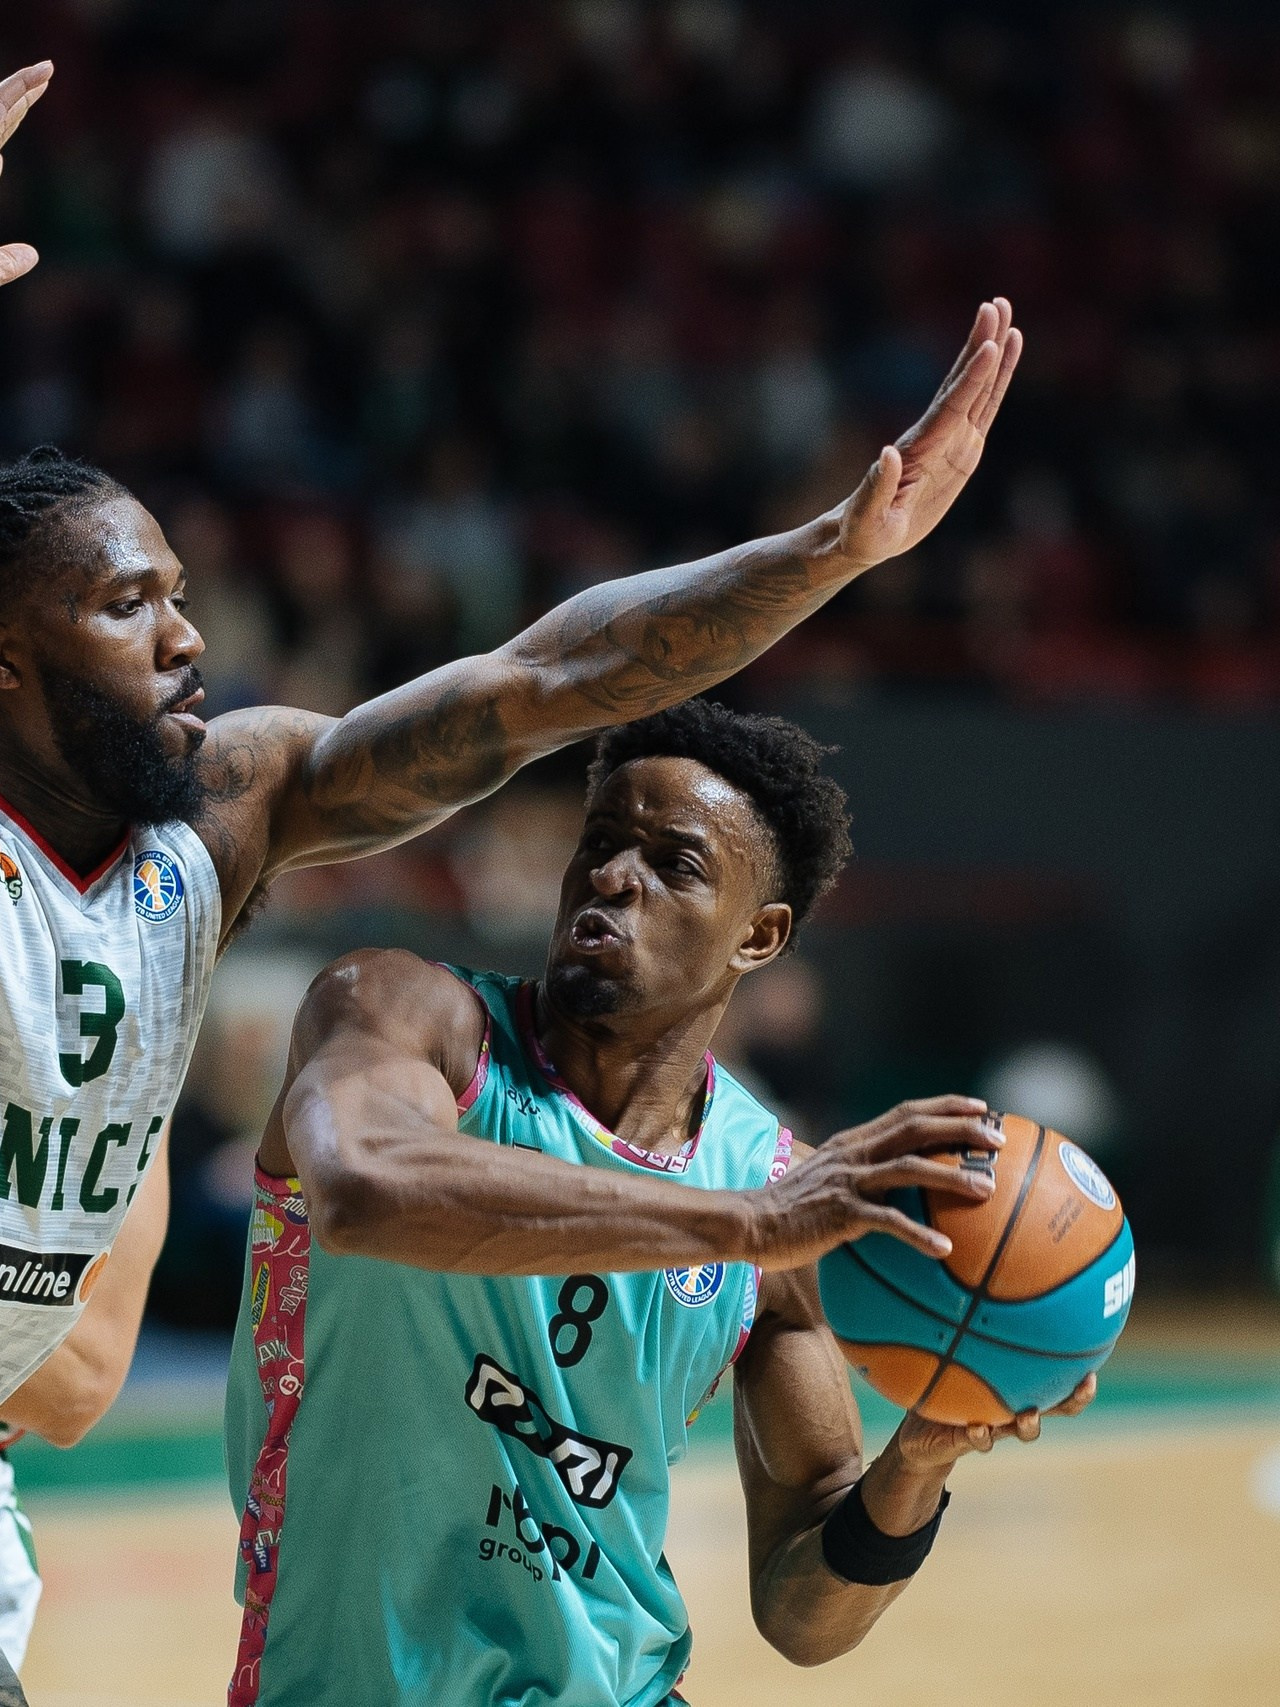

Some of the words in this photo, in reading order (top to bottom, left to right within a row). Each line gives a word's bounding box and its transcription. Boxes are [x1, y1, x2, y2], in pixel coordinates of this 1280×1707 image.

[60, 959, 125, 1088] 3
[549, 1275, 609, 1368] 8
[478, 1538, 544, 1583] group
